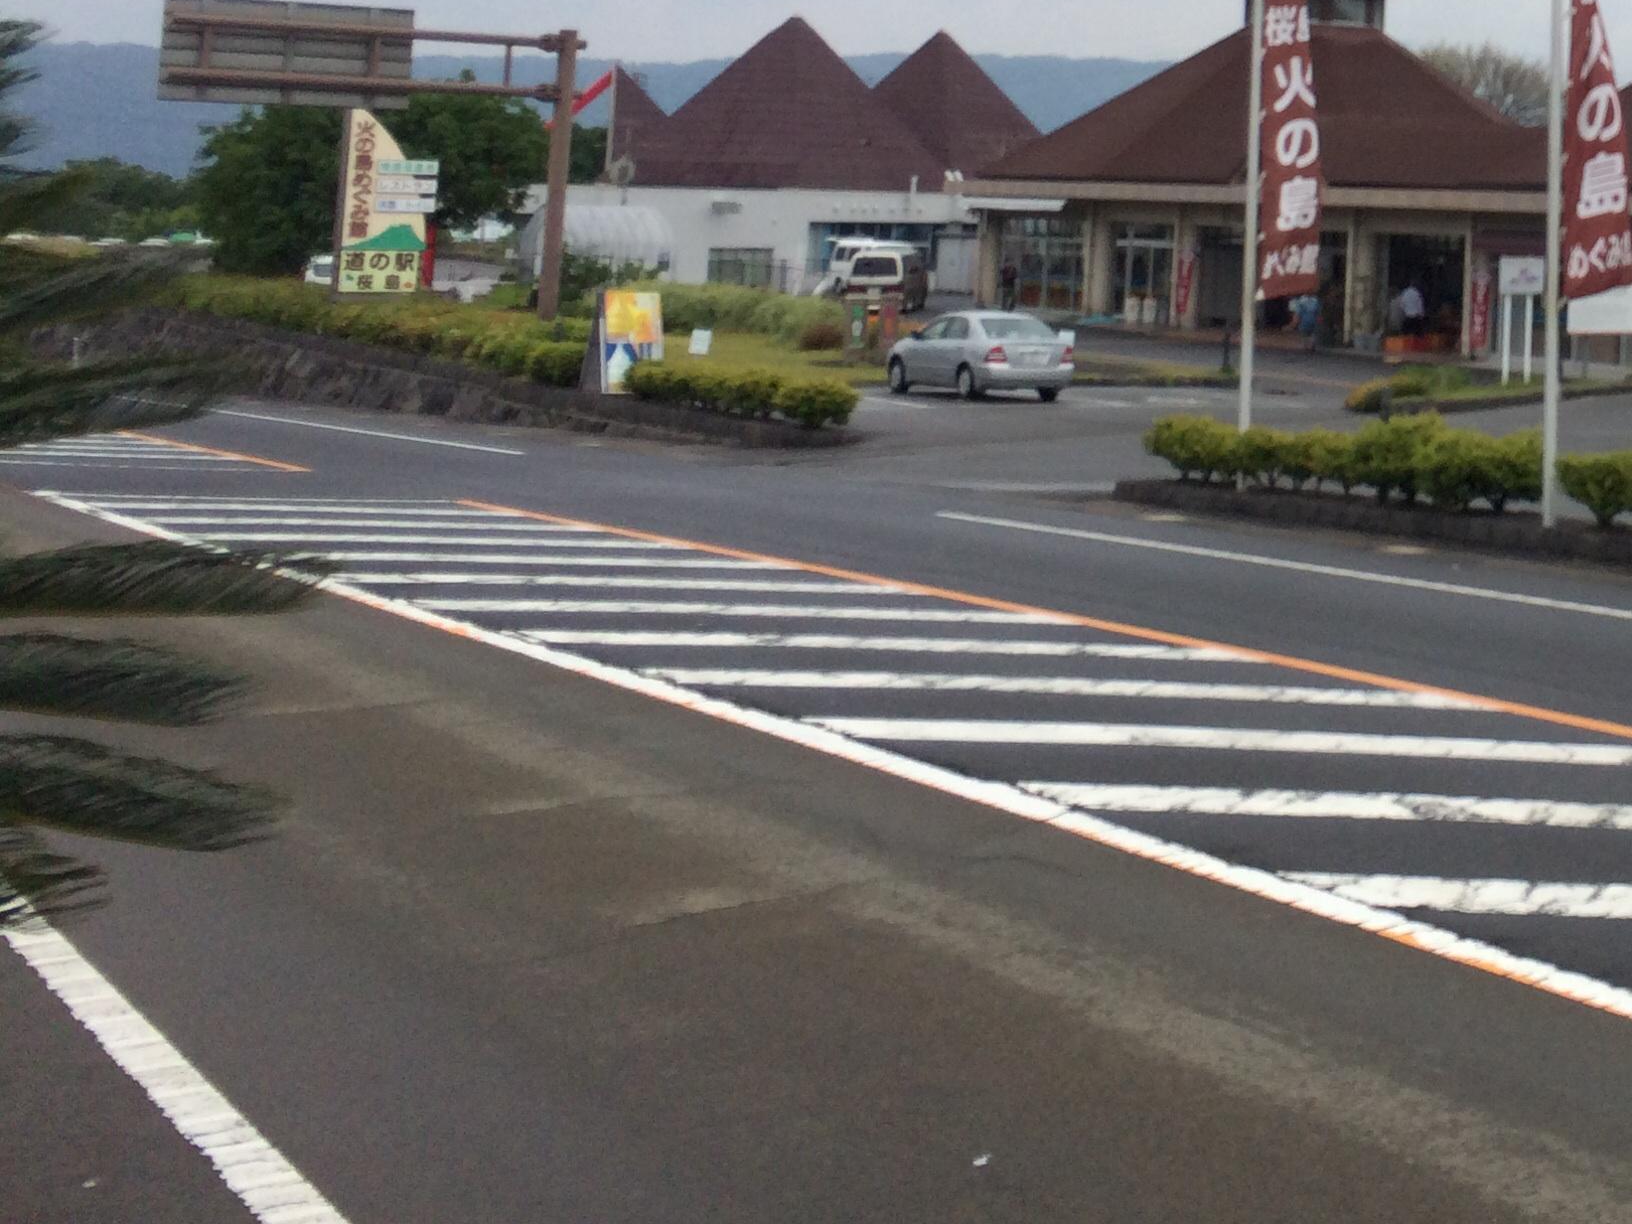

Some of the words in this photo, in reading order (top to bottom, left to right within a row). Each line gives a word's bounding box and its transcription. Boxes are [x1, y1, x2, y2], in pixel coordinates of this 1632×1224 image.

[1272, 55, 1320, 230] 火の島
[343, 251, 415, 273] 道の駅
[356, 274, 401, 291] 桜島
